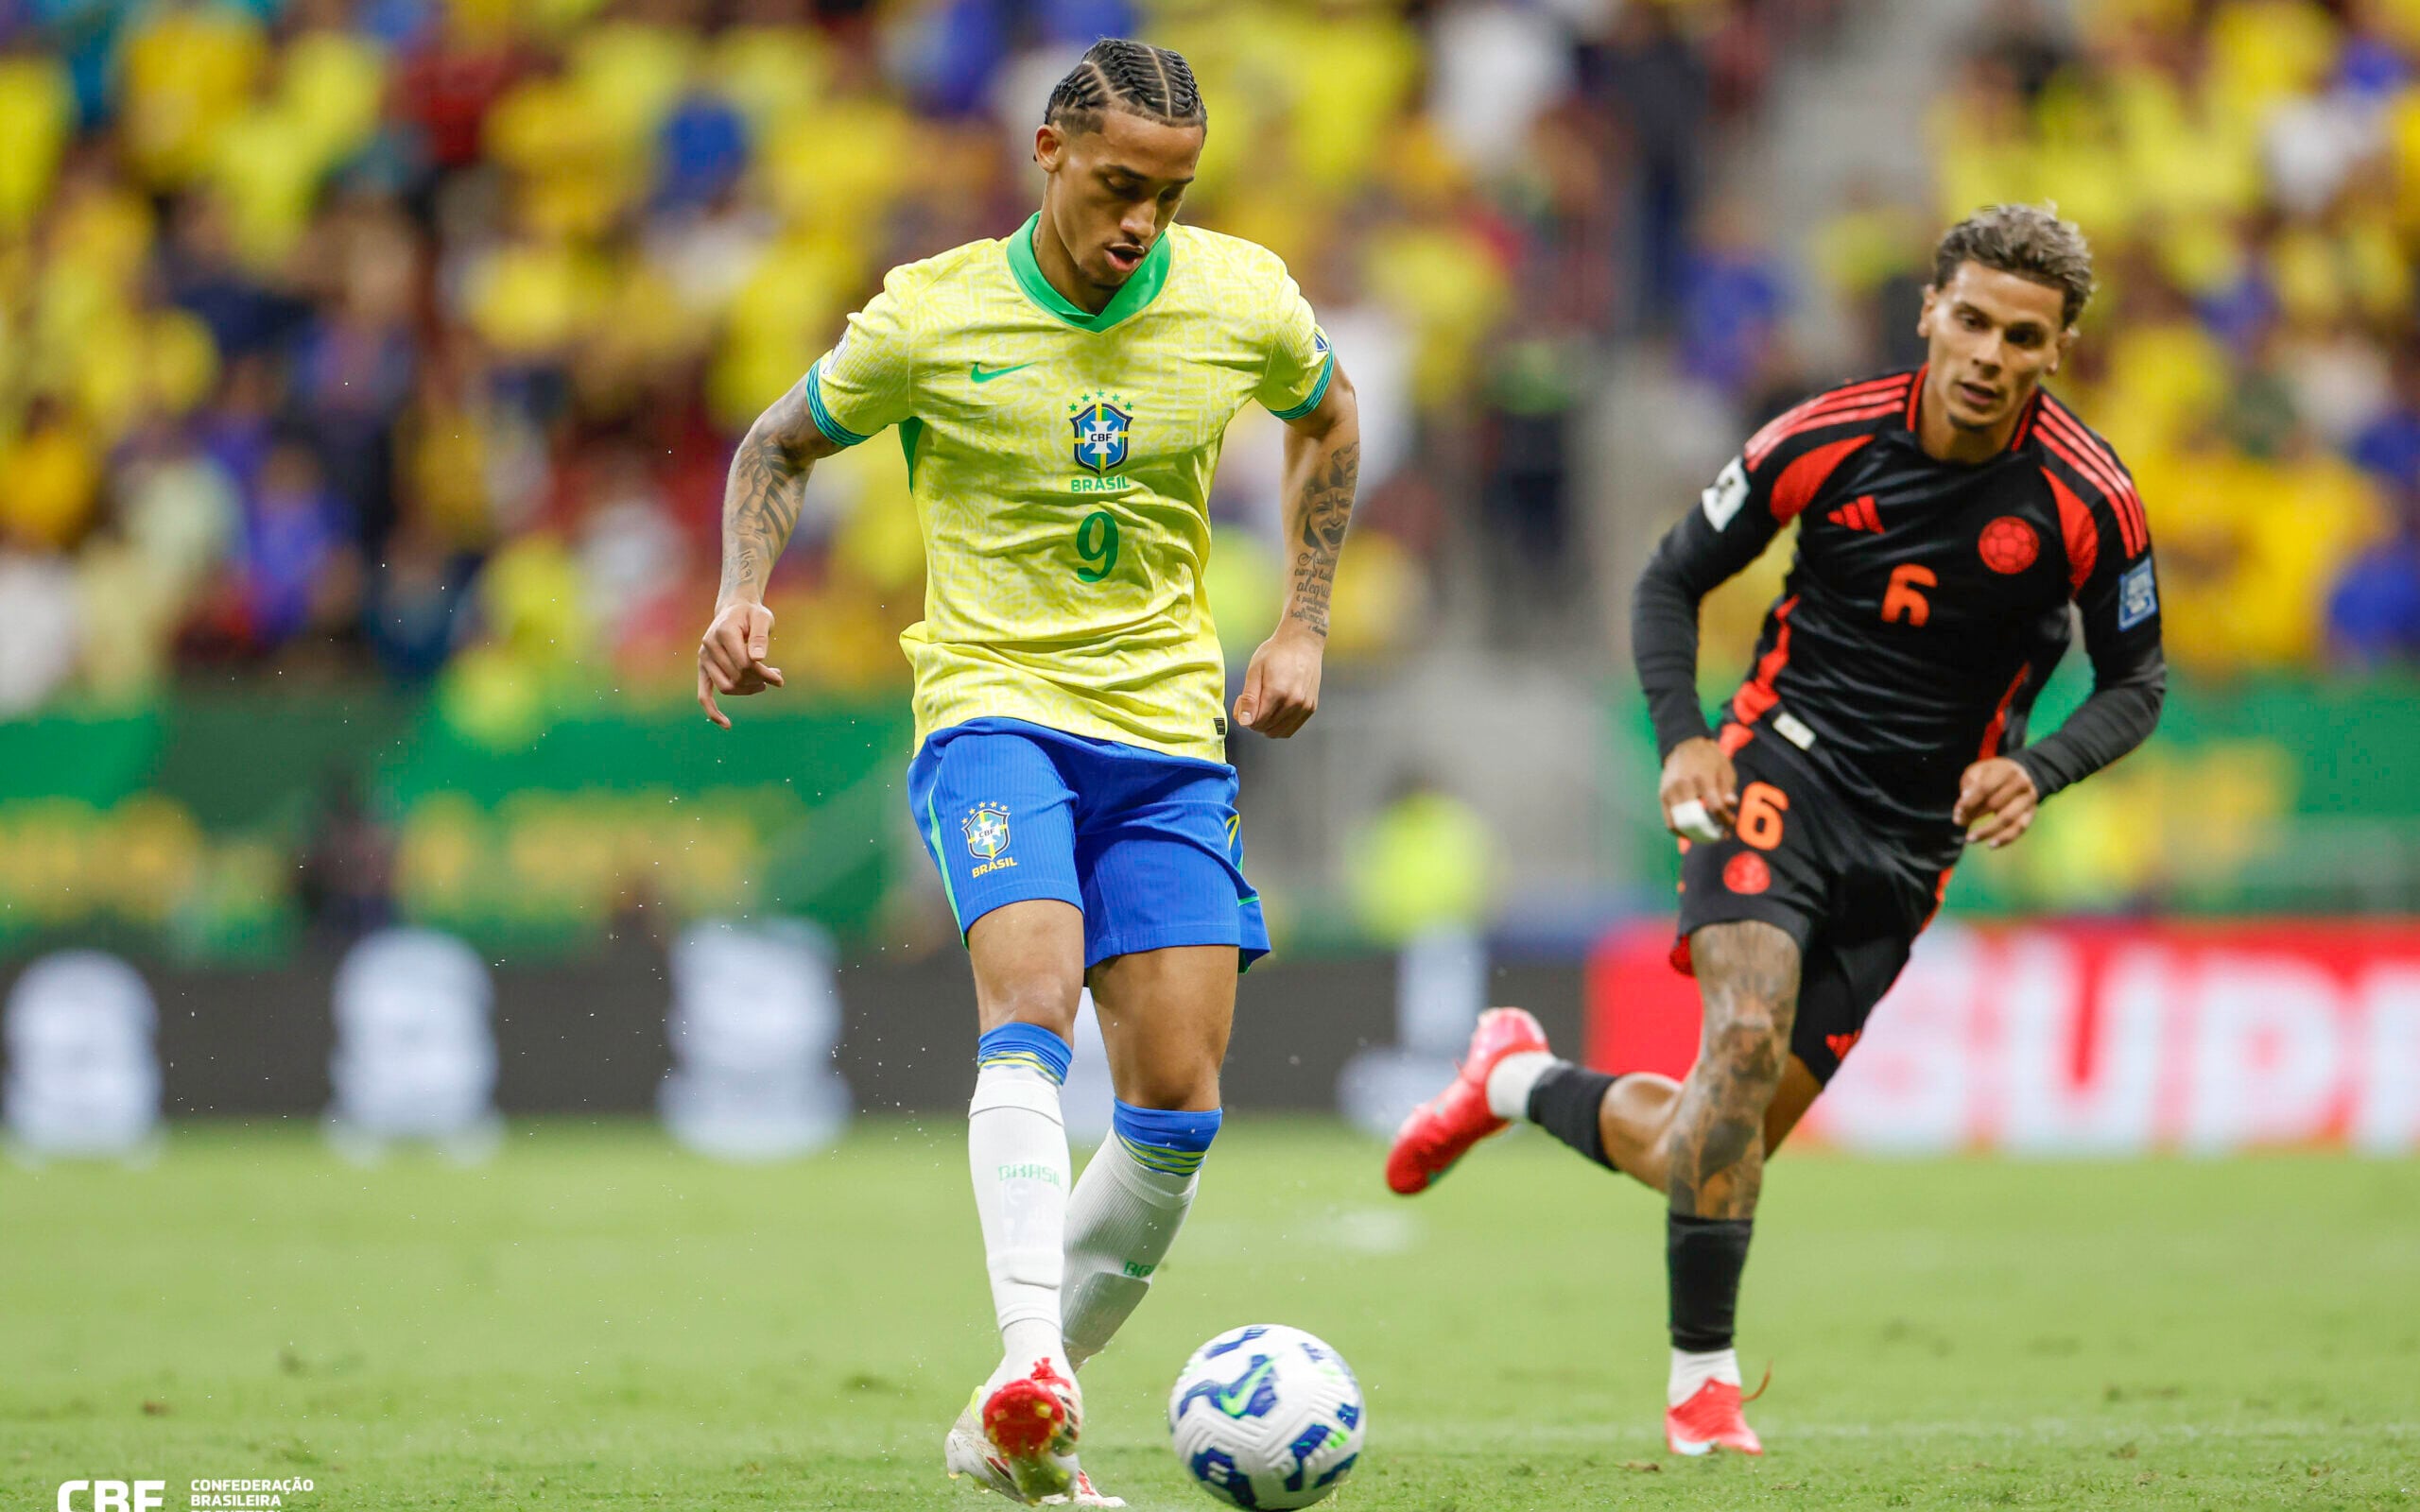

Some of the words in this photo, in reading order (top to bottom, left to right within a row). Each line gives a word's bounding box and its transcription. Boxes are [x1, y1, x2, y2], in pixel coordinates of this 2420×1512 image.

[1091, 433, 1113, 442] CBF
[1071, 475, 1131, 492] BRASIL
[1077, 511, 1118, 582] 9
[1881, 563, 1937, 627] 6
[1736, 781, 1789, 850] 6
[978, 828, 995, 838] CBF
[972, 857, 1017, 878] BRASIL
